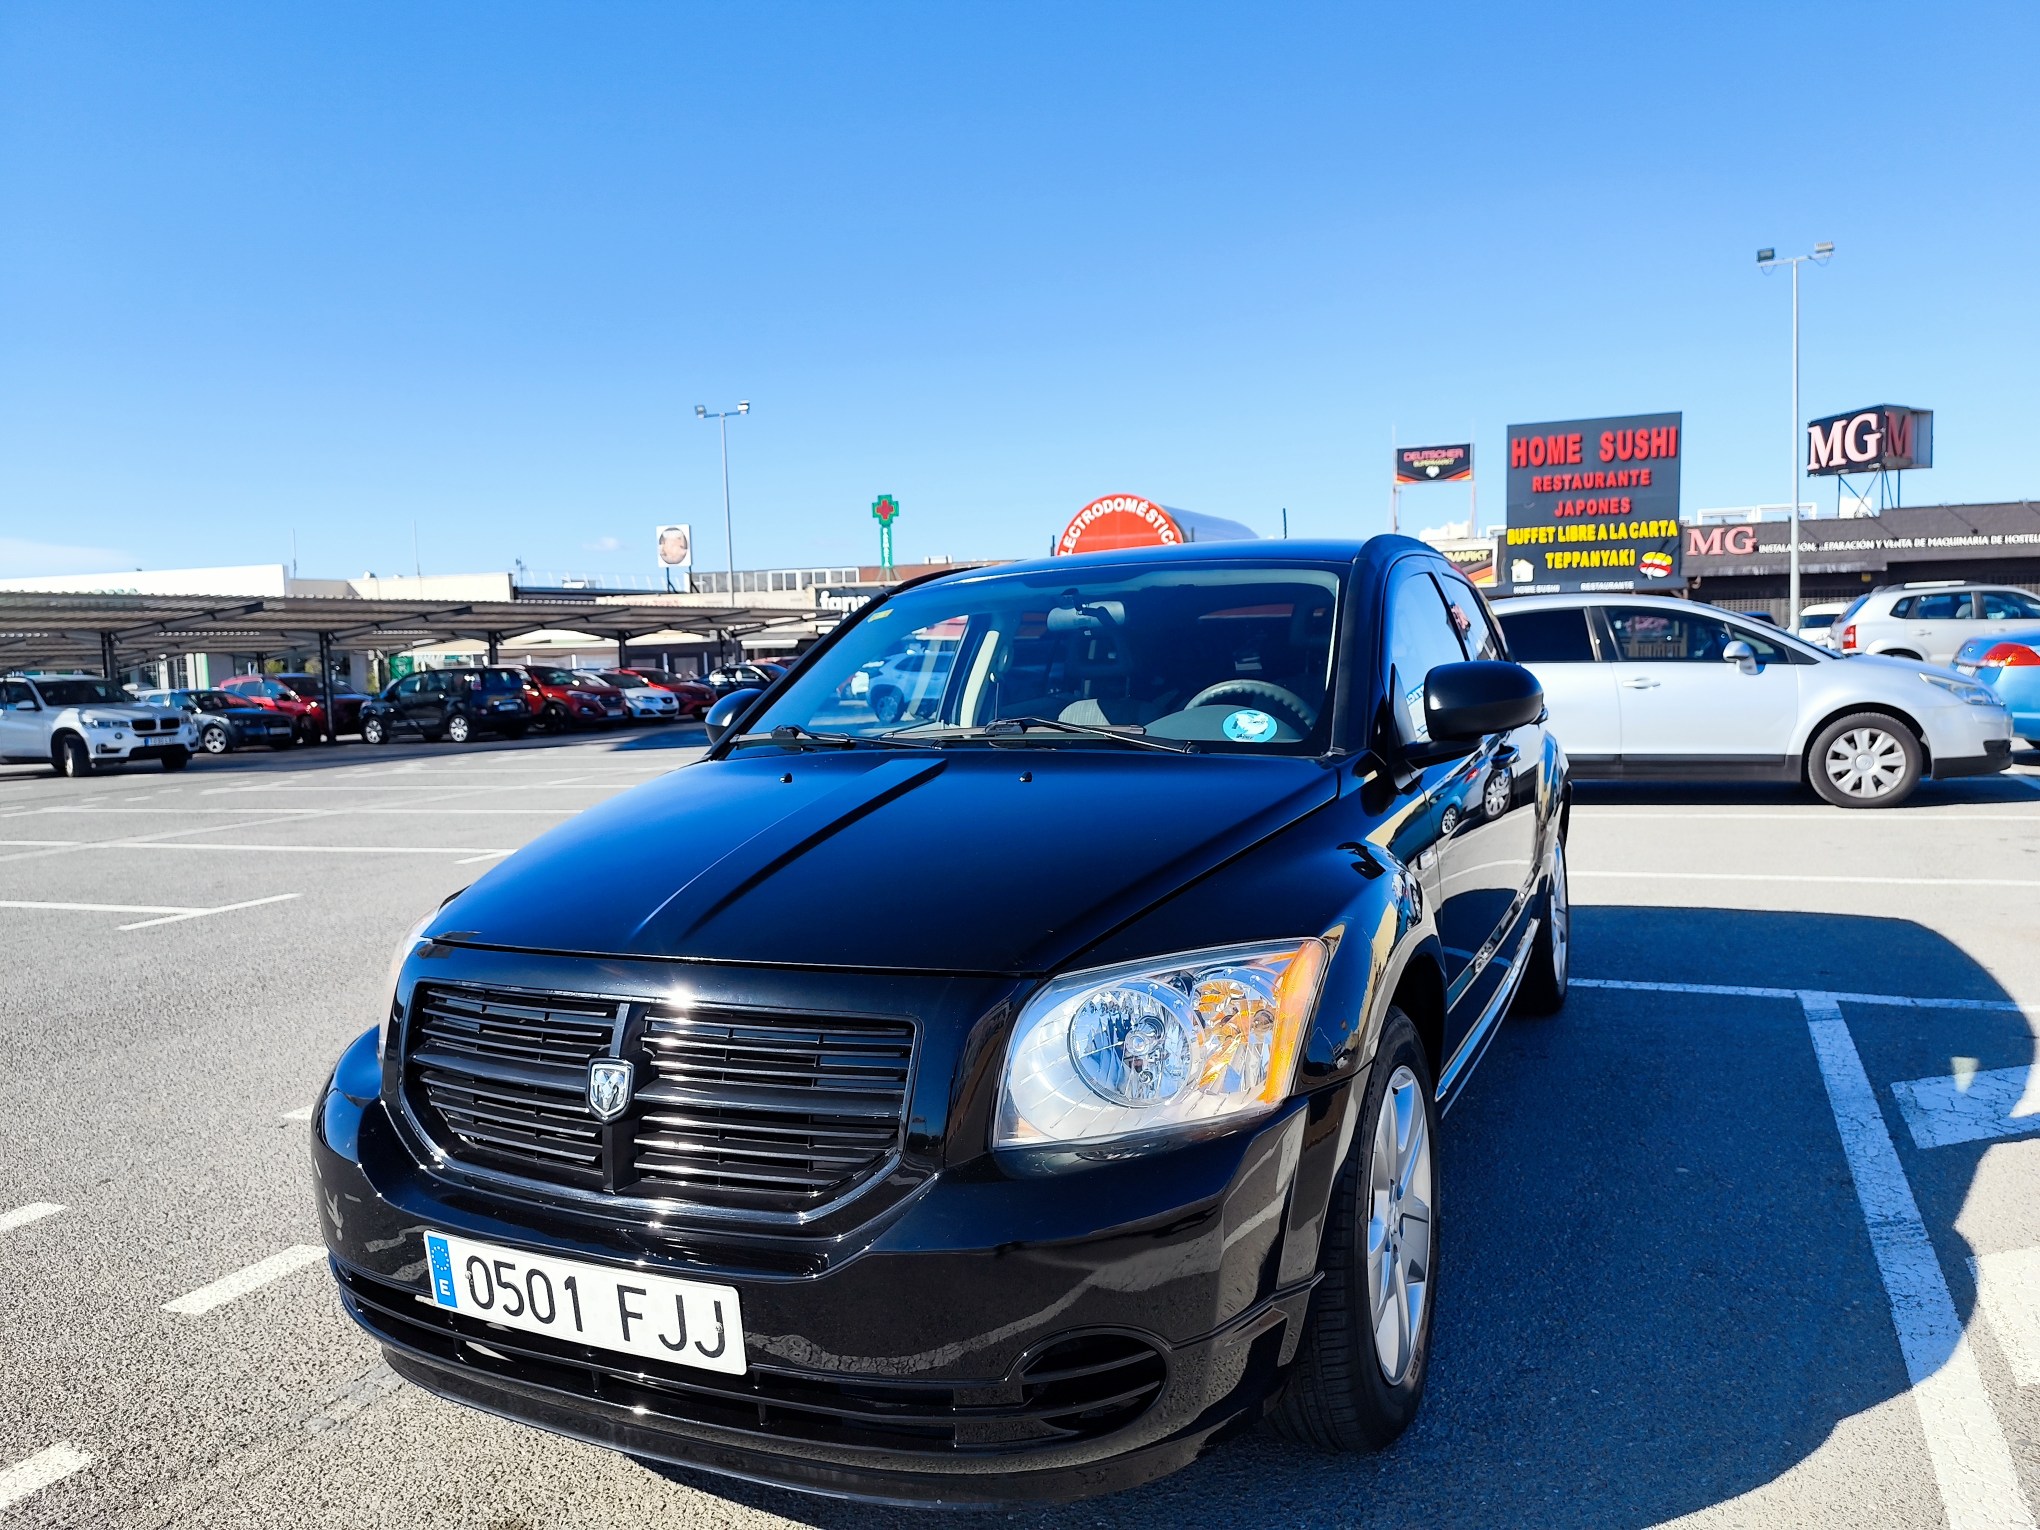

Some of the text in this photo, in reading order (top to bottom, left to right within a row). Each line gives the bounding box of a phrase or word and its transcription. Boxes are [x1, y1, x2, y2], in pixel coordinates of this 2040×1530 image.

[1511, 426, 1677, 468] HOME SUSHI
[1808, 412, 1883, 471] MG
[1403, 448, 1464, 462] DEUTSCHER
[1532, 468, 1651, 493] RESTAURANTE
[1554, 496, 1631, 517] JAPONES
[1059, 497, 1178, 556] LECTRODOMÉSTIC
[1507, 520, 1678, 546] BUFFET LIBRE A LA CARTA
[1687, 526, 1758, 556] MG
[1758, 541, 1817, 554] INSTALAIÓN,
[1914, 537, 1926, 548] DE
[1927, 535, 1989, 547] MAQUINARIA
[1990, 535, 2003, 545] DE
[1545, 548, 1636, 570] TEPPANYAKI
[1513, 585, 1536, 594] HOME
[1580, 580, 1635, 591] RESTAURANTE
[439, 1281, 451, 1296] E
[466, 1255, 726, 1358] 0501 FJJ
